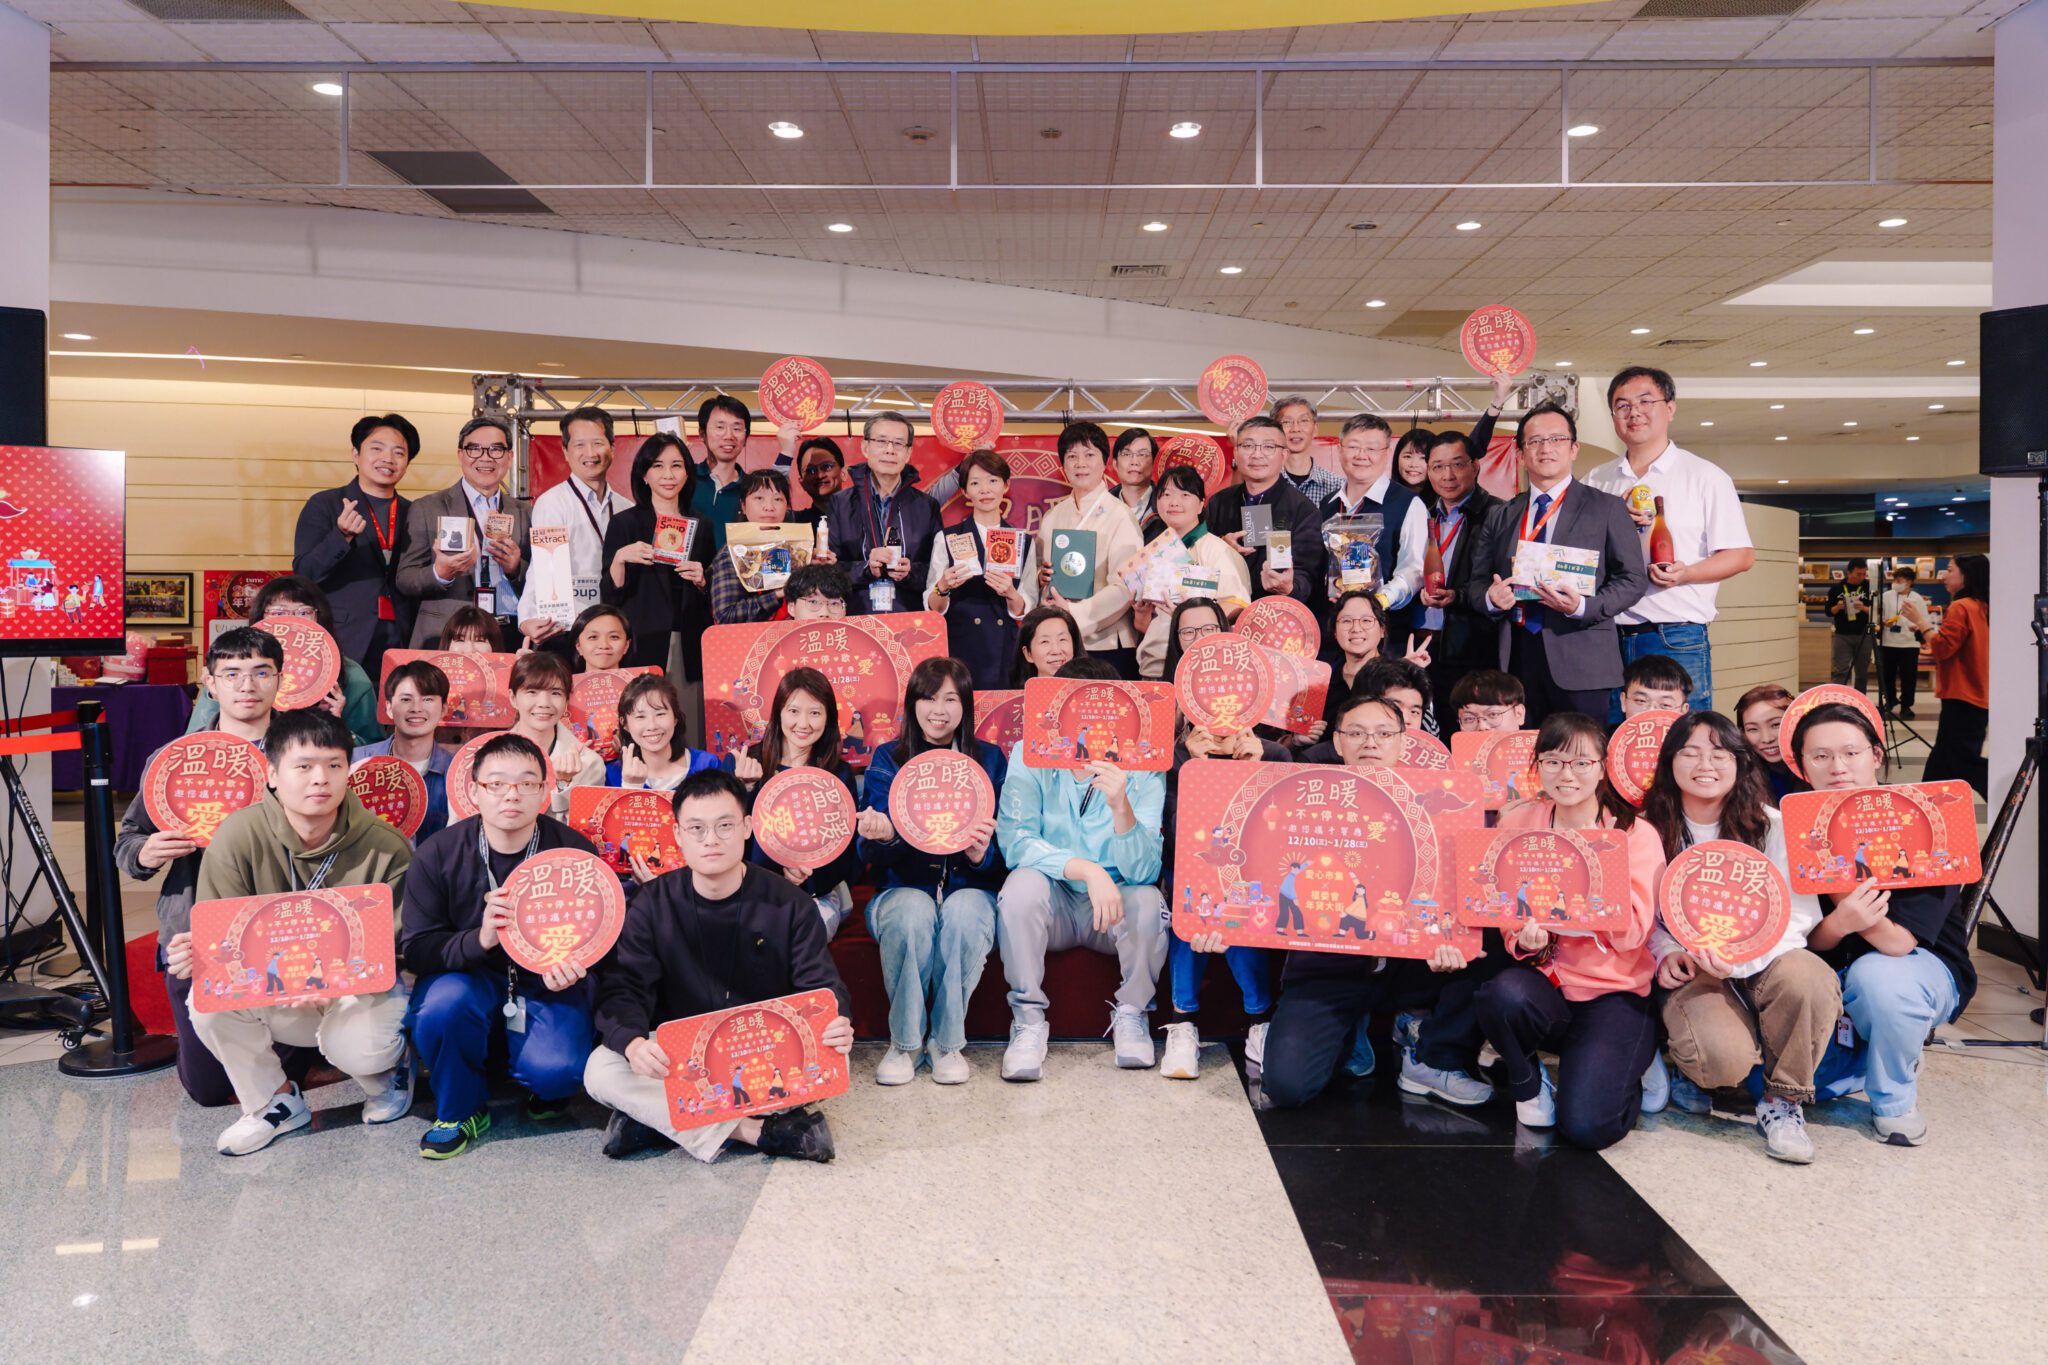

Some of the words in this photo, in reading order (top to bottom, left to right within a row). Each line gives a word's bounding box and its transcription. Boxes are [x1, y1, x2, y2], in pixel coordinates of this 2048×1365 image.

[1470, 309, 1519, 336] 溫暖
[761, 358, 810, 401] 溫暖
[795, 396, 826, 427] 愛
[943, 388, 989, 411] 溫暖
[952, 424, 979, 450] 愛
[1172, 436, 1218, 468] 溫暖
[532, 534, 566, 544] Extract
[573, 588, 598, 600] oup
[799, 627, 850, 653] 溫暖
[800, 653, 851, 665] 不停歇
[858, 658, 874, 676] 愛
[1190, 641, 1254, 673] 溫暖
[1085, 686, 1115, 702] 溫暖
[1210, 694, 1243, 730] 愛
[1626, 721, 1671, 749] 溫
[168, 744, 250, 779] 溫暖
[906, 759, 974, 791] 溫暖
[349, 761, 406, 797] 溫暖
[629, 795, 658, 809] 溫暖
[1296, 778, 1360, 809] 溫暖
[1855, 792, 1895, 812] 溫暖
[184, 801, 229, 841] 愛
[758, 806, 796, 842] 愛
[811, 778, 851, 845] 溫暖
[1296, 809, 1358, 823] 不停歇
[923, 811, 960, 849] 愛
[1367, 821, 1387, 842] 愛
[1522, 835, 1558, 852] 溫暖
[517, 858, 599, 900] 溫暖
[1305, 869, 1344, 881] 愛心市集
[1687, 850, 1769, 899] 溫暖
[274, 898, 315, 919] 溫暖
[534, 898, 586, 911] 不停歇
[1305, 901, 1344, 911] 年貨大街
[536, 923, 581, 967] 愛
[1692, 911, 1741, 960] 愛
[729, 1010, 768, 1034] 溫暖
